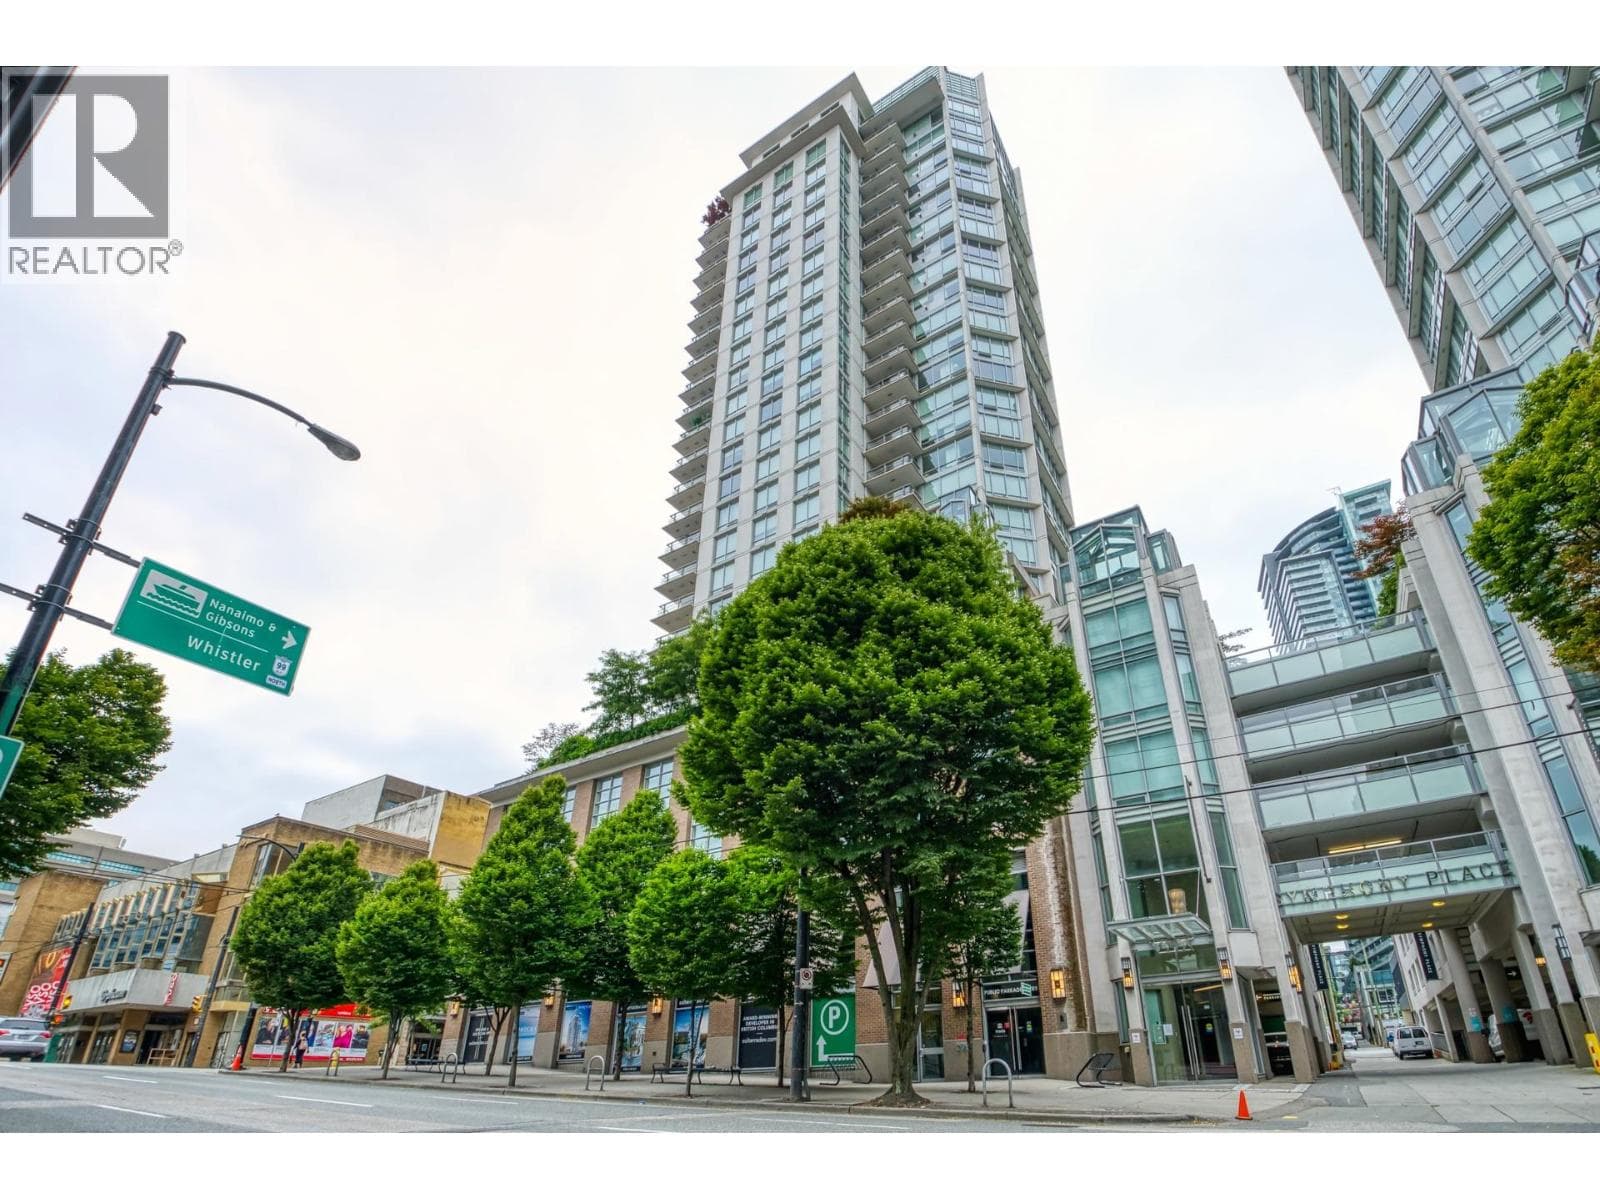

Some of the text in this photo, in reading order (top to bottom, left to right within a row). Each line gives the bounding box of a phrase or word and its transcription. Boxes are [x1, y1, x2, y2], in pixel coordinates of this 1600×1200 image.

[205, 612, 256, 638] Gibsons
[209, 598, 277, 632] Nanaimo &
[187, 635, 261, 672] Whistler
[276, 662, 287, 671] 99
[268, 676, 286, 687] NORTH
[828, 1006, 841, 1029] P
